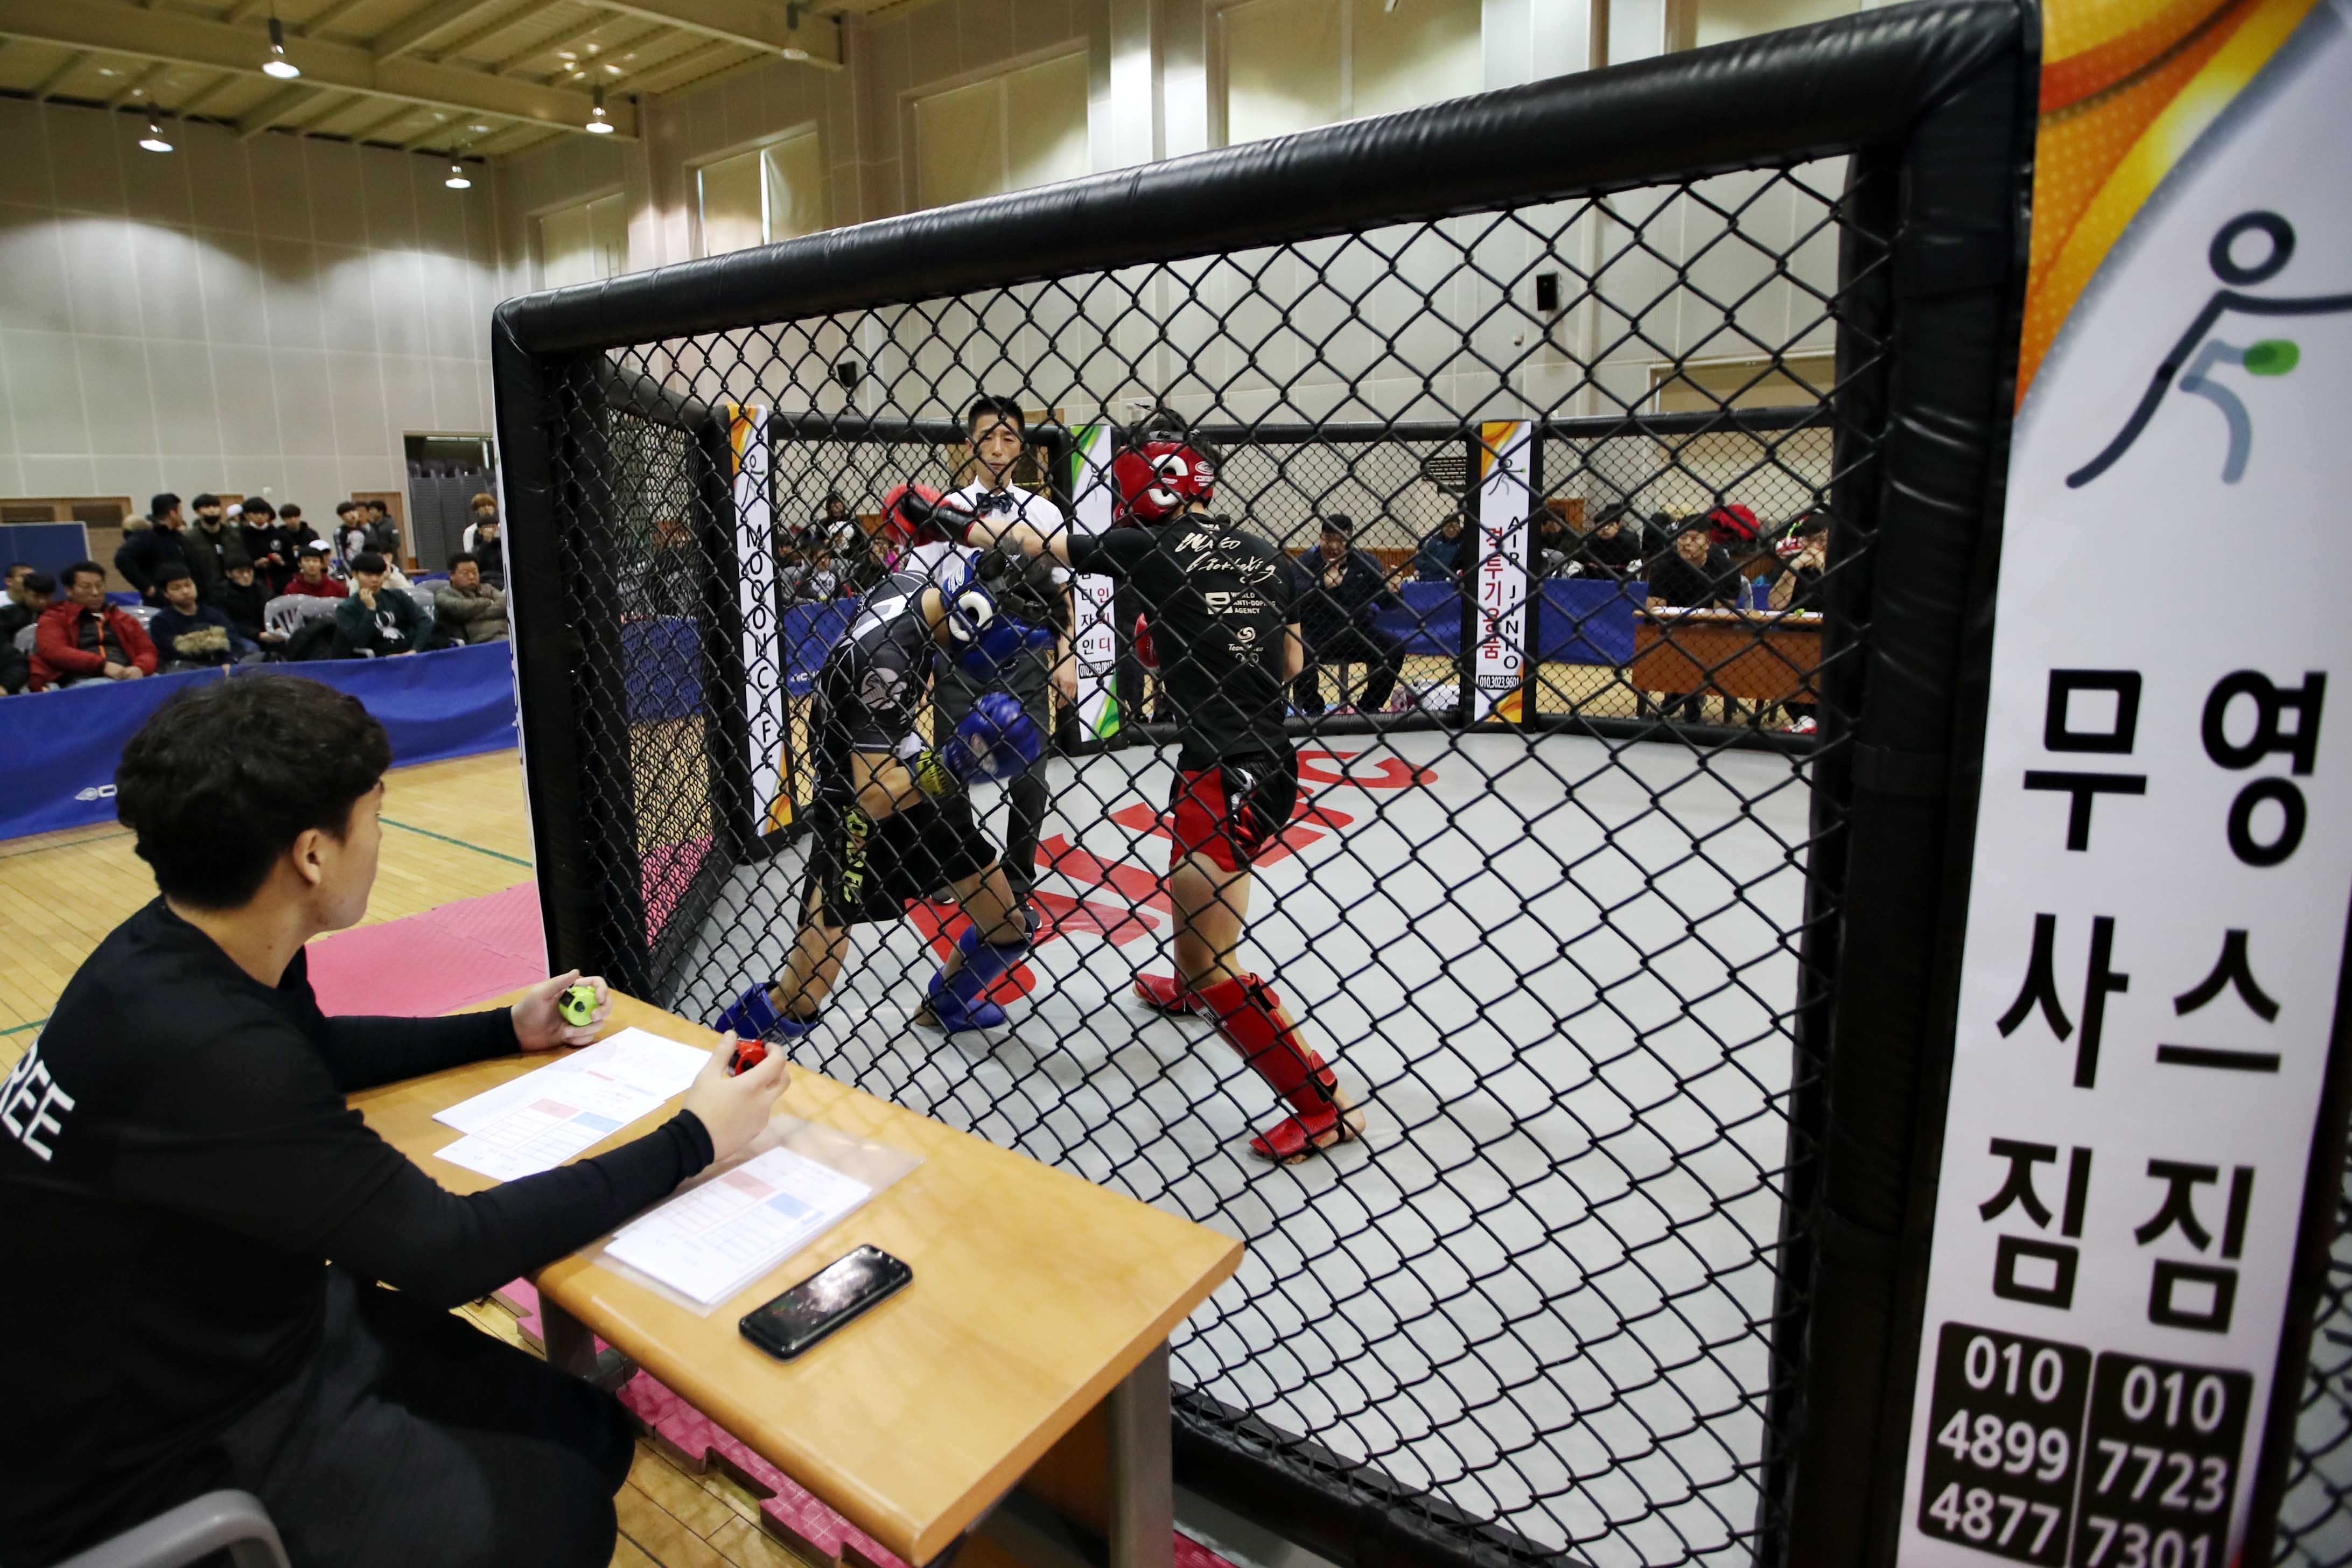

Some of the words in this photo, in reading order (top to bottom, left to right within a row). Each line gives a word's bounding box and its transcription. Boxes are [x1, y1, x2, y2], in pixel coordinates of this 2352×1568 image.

[1978, 669, 2147, 1310] 무사짐
[2133, 669, 2328, 1334] 영스짐
[1964, 1335, 2063, 1402] 010
[2122, 1366, 2225, 1433] 010
[1937, 1409, 2070, 1482] 4899
[2097, 1439, 2228, 1511] 7723
[1929, 1482, 2061, 1556] 4877
[2087, 1515, 2209, 1568] 7301
